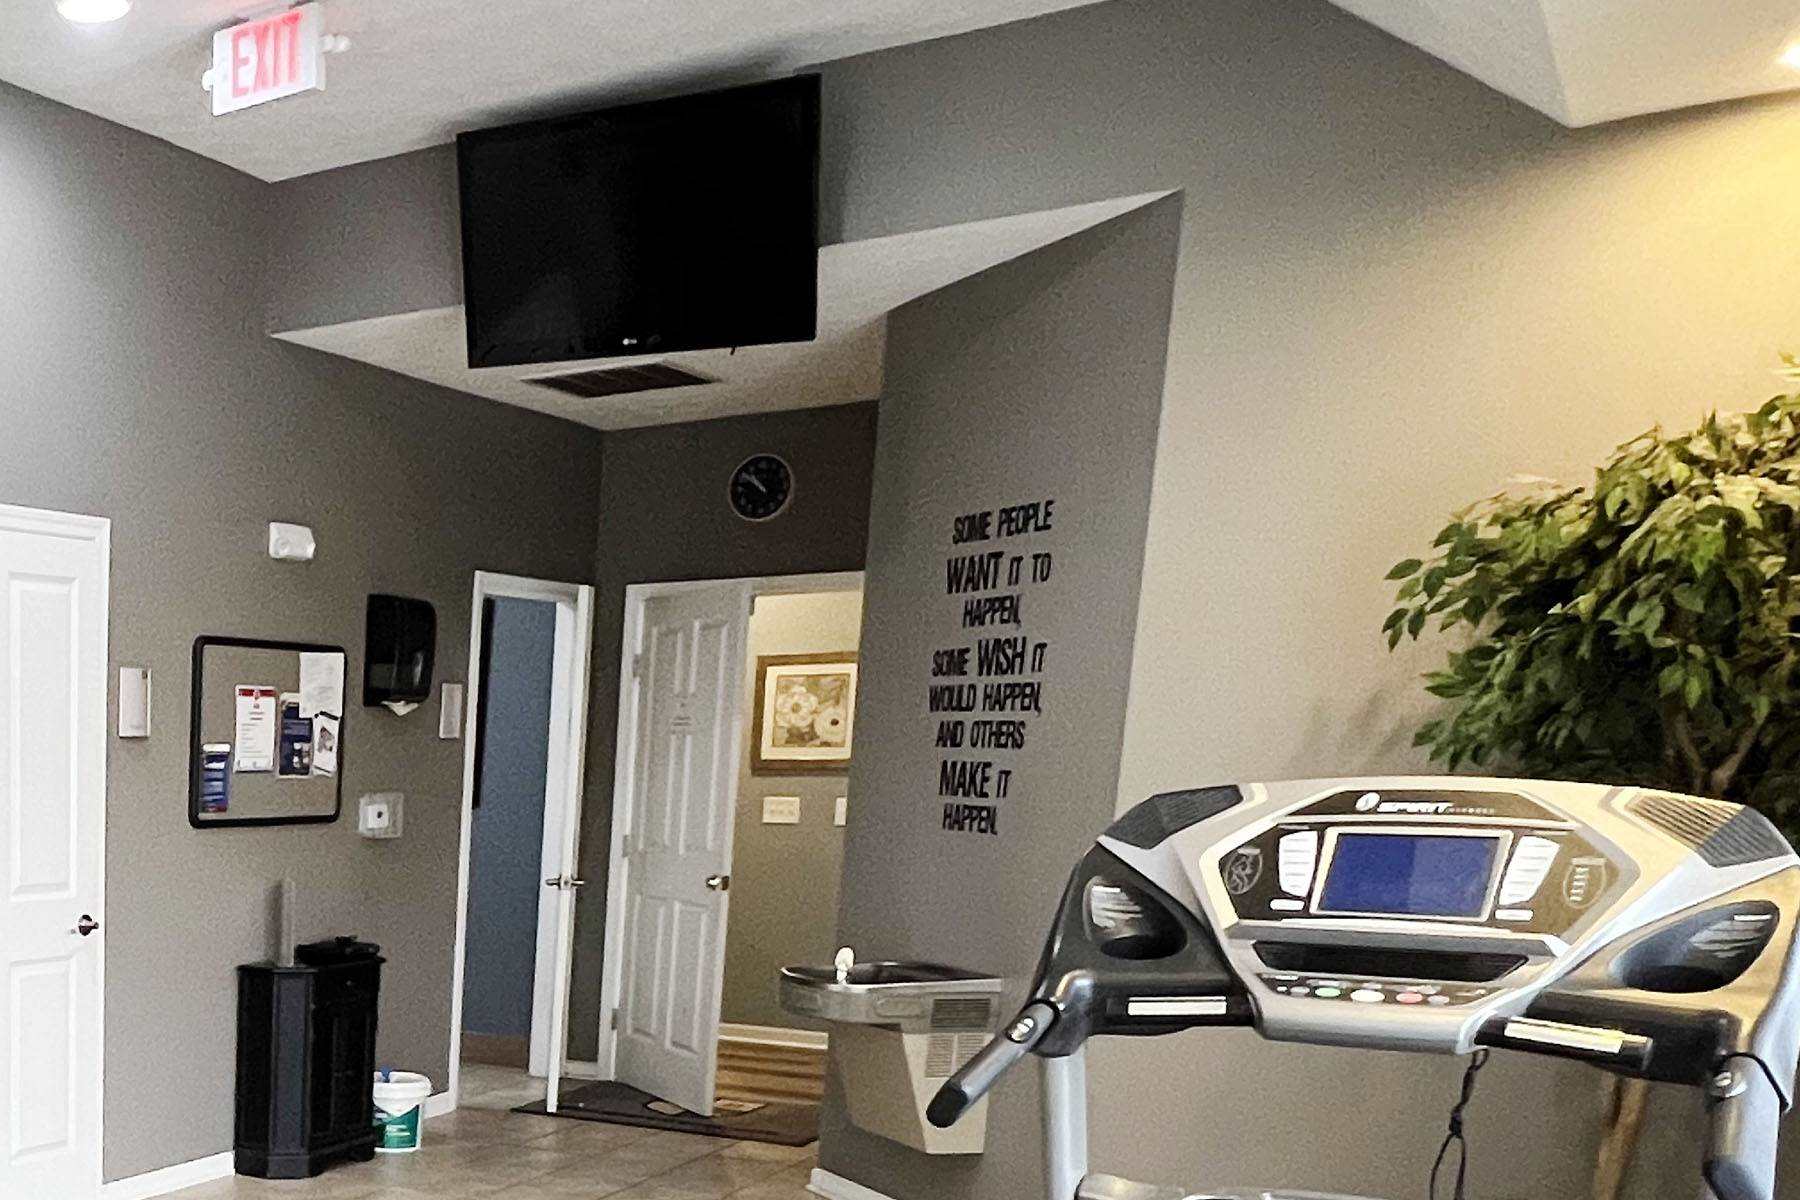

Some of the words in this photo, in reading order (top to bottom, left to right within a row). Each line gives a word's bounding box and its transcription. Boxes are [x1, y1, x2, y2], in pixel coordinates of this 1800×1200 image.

[231, 12, 301, 98] EXIT
[953, 511, 991, 544] SOME
[998, 500, 1054, 537] PEOPLE
[946, 552, 1004, 594] WANT
[1008, 556, 1023, 586] IT
[1032, 552, 1051, 583] TO
[932, 647, 970, 677] SOME
[977, 637, 1026, 677] WISH
[1032, 642, 1047, 673] IT
[929, 684, 977, 713] WOULD
[935, 720, 964, 748] AND
[970, 720, 1025, 749] OTHERS
[939, 760, 991, 798] MAKE
[996, 769, 1011, 798] IT
